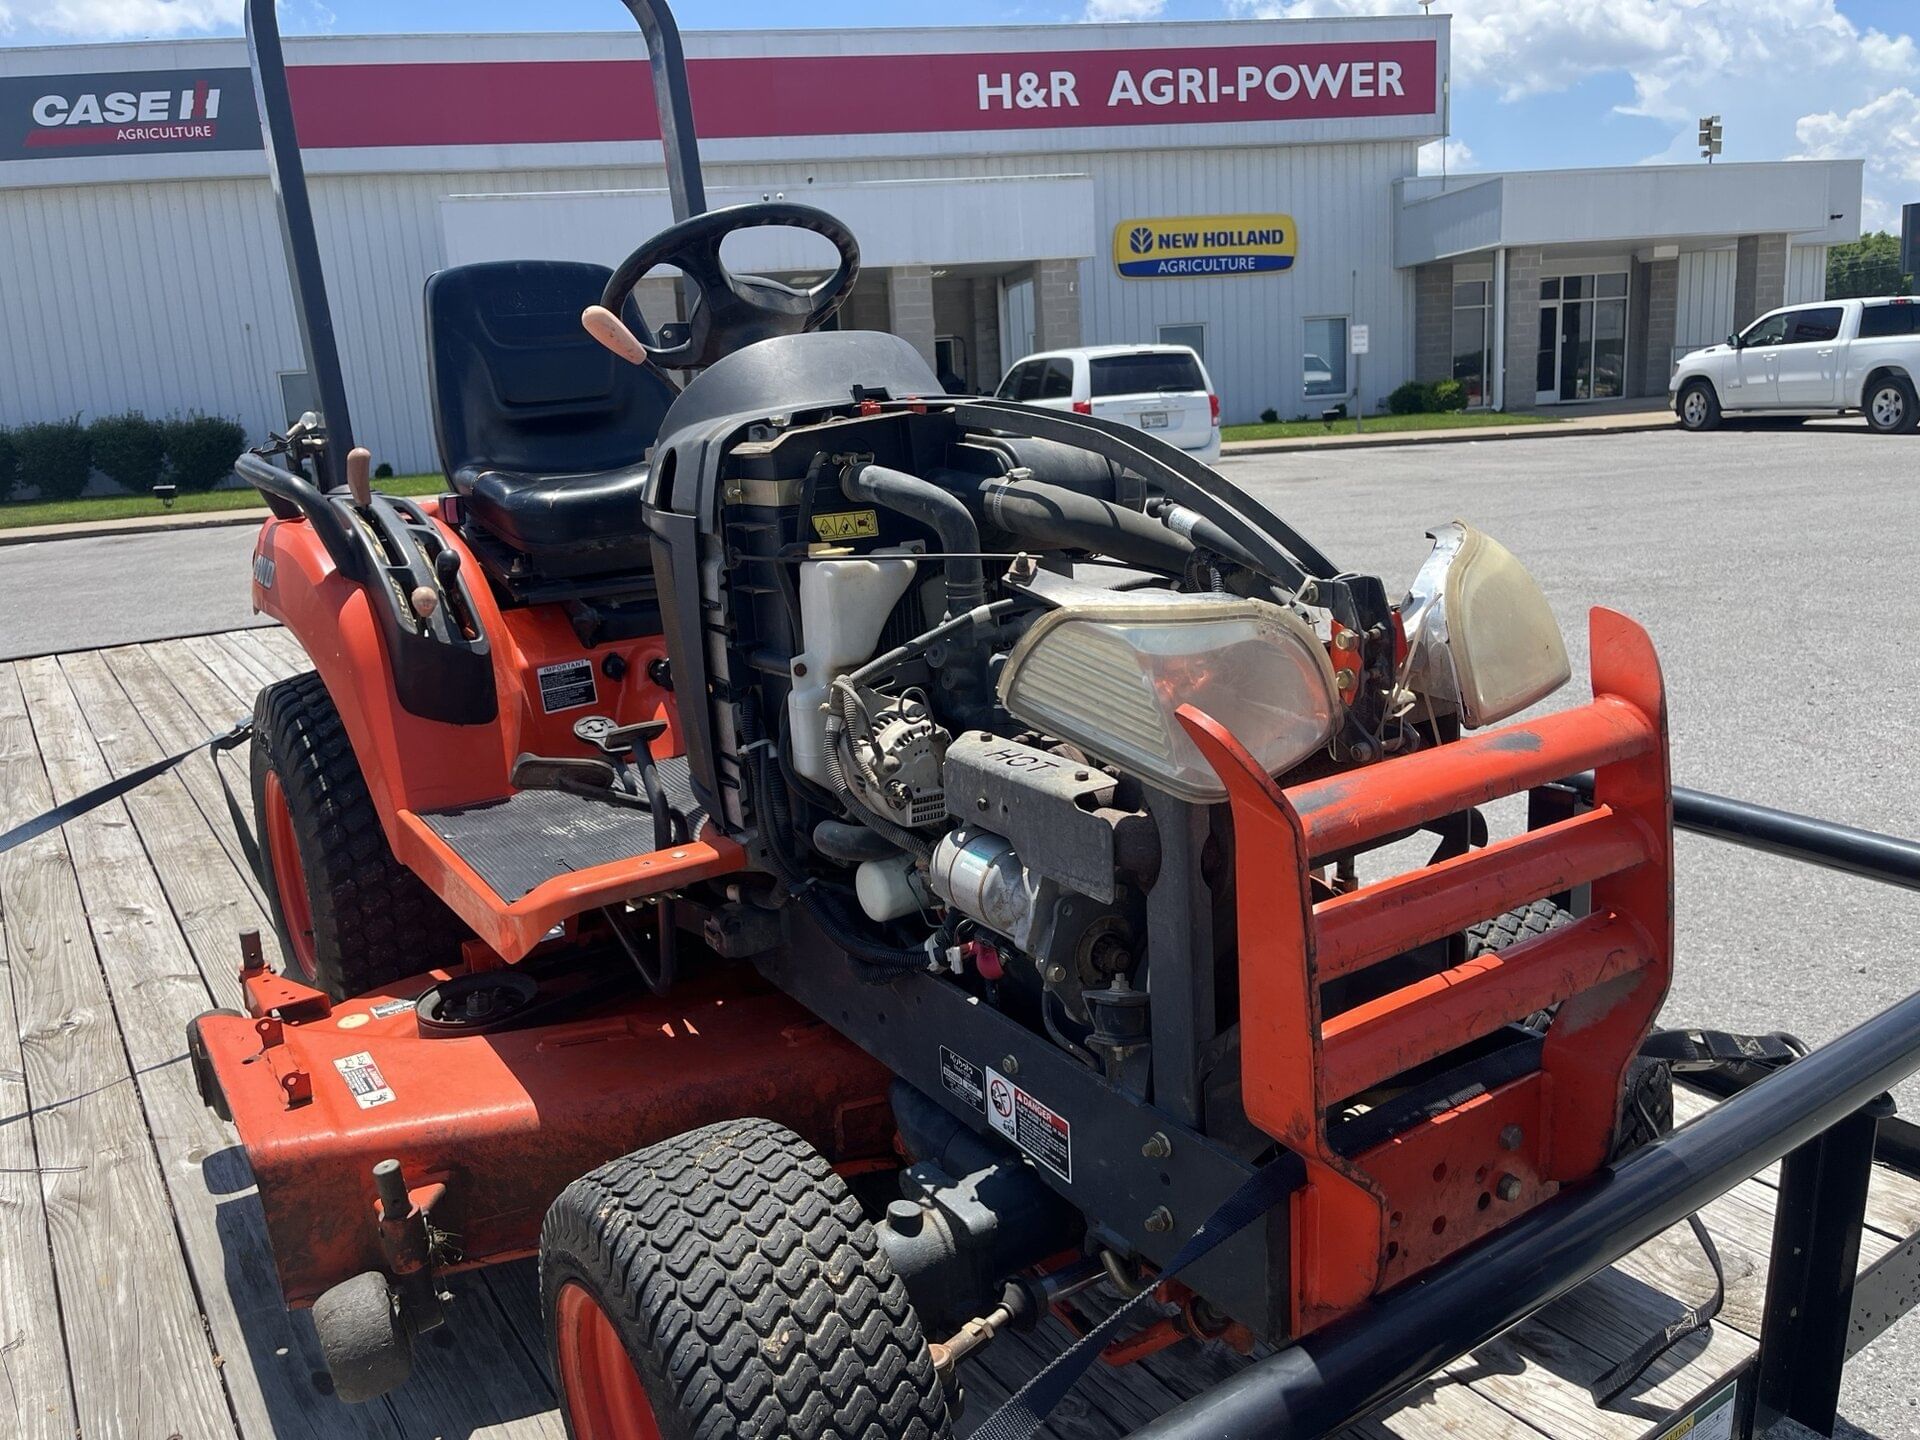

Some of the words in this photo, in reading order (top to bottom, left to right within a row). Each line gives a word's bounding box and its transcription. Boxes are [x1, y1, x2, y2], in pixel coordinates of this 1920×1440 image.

[976, 70, 1080, 111] H&R
[1106, 61, 1406, 107] AGRI-POWER
[32, 90, 172, 127] CASE
[116, 125, 212, 141] AGRICULTURE
[1158, 232, 1199, 250] NEW
[1203, 229, 1284, 248] HOLLAND
[1157, 257, 1256, 274] AGRICULTURE
[543, 660, 585, 673] IMPORTANT
[984, 748, 1061, 772] HOT
[1023, 1096, 1052, 1124] DANGER
